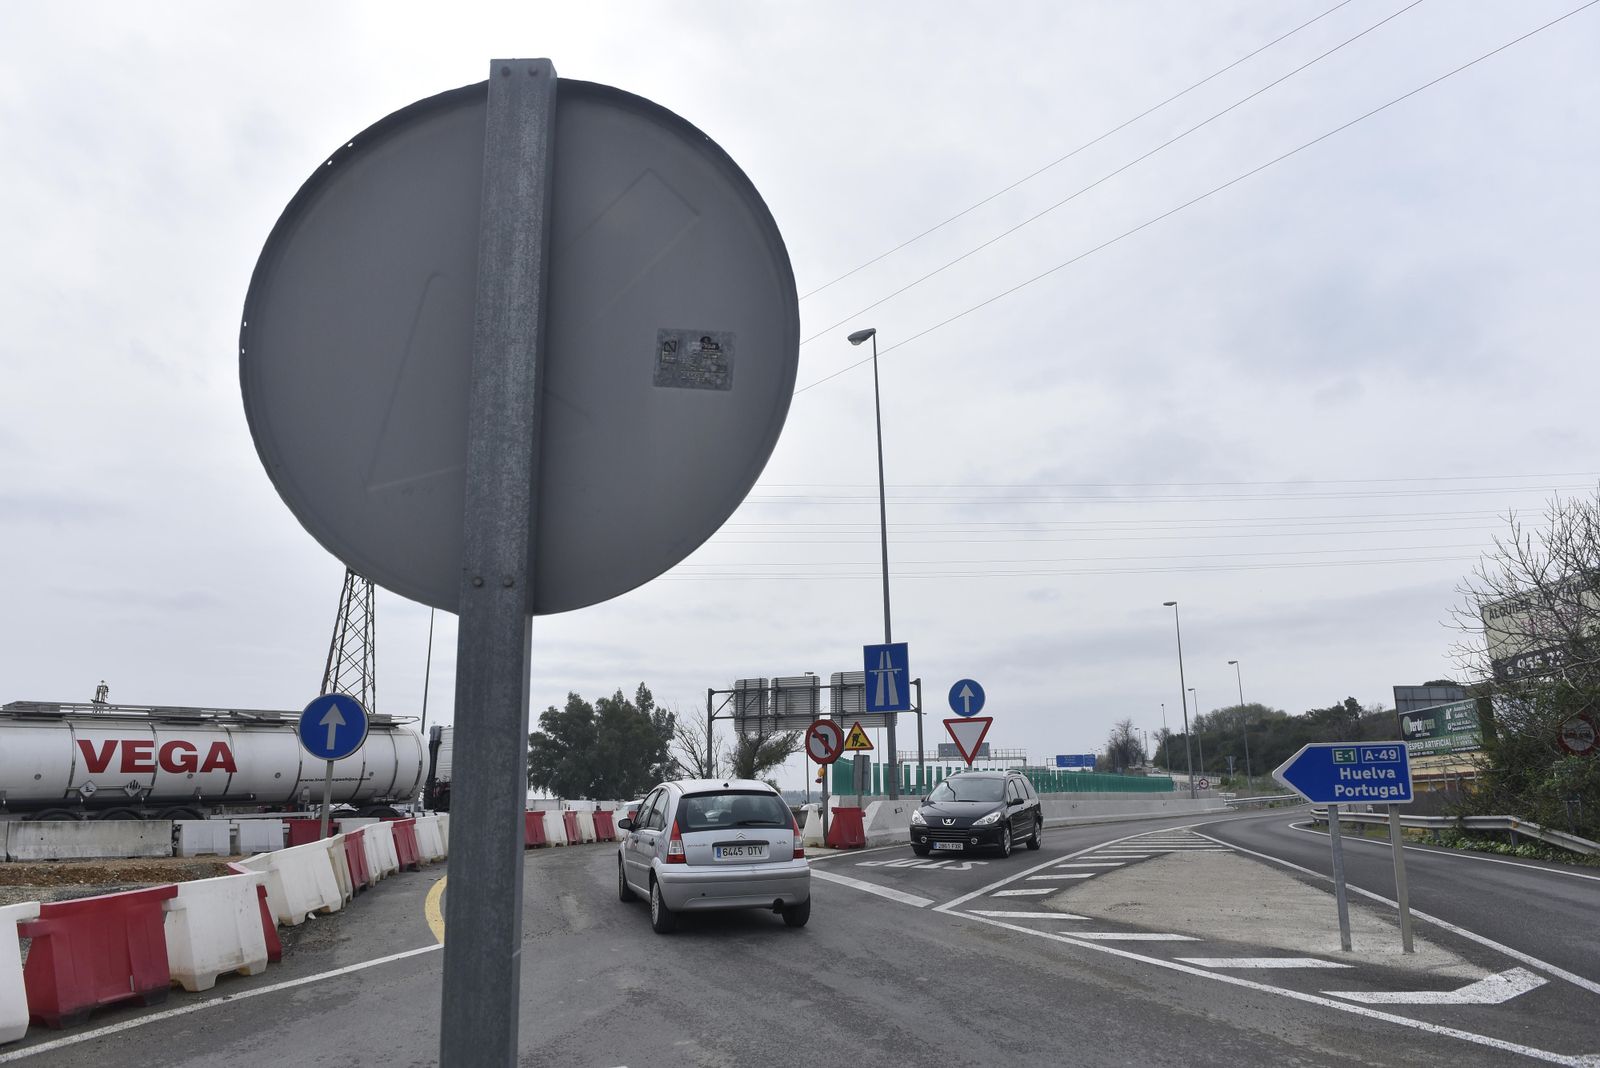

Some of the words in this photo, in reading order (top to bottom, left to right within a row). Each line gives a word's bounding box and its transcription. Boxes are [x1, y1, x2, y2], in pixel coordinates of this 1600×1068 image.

[77, 740, 238, 774] VEGA
[1336, 751, 1355, 761] E-1
[1365, 750, 1397, 761] A-49
[1340, 767, 1396, 780] Huelva
[1335, 783, 1405, 798] Portugal
[723, 847, 743, 857] 6445
